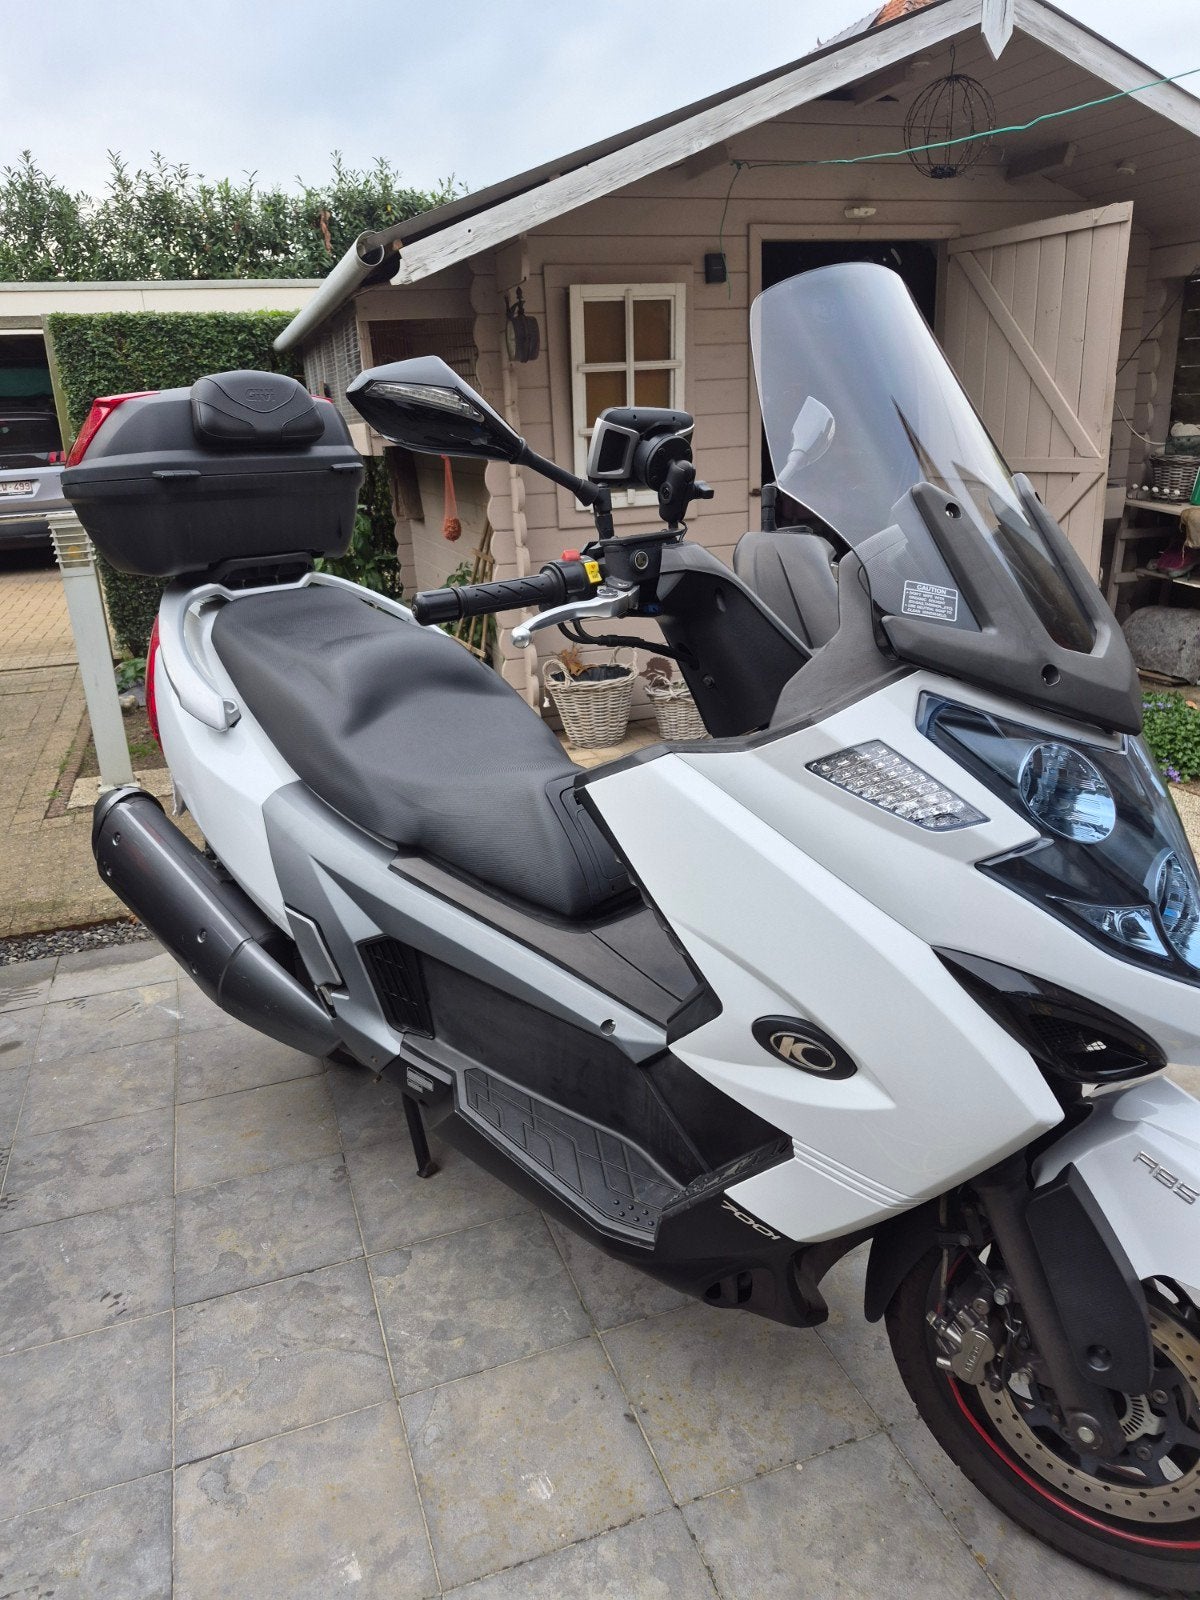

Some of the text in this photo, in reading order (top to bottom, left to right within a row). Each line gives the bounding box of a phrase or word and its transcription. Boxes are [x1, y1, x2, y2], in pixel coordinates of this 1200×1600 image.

[0, 481, 31, 491] W-499
[916, 584, 947, 595] CAUTION
[1132, 1150, 1200, 1206] ABS
